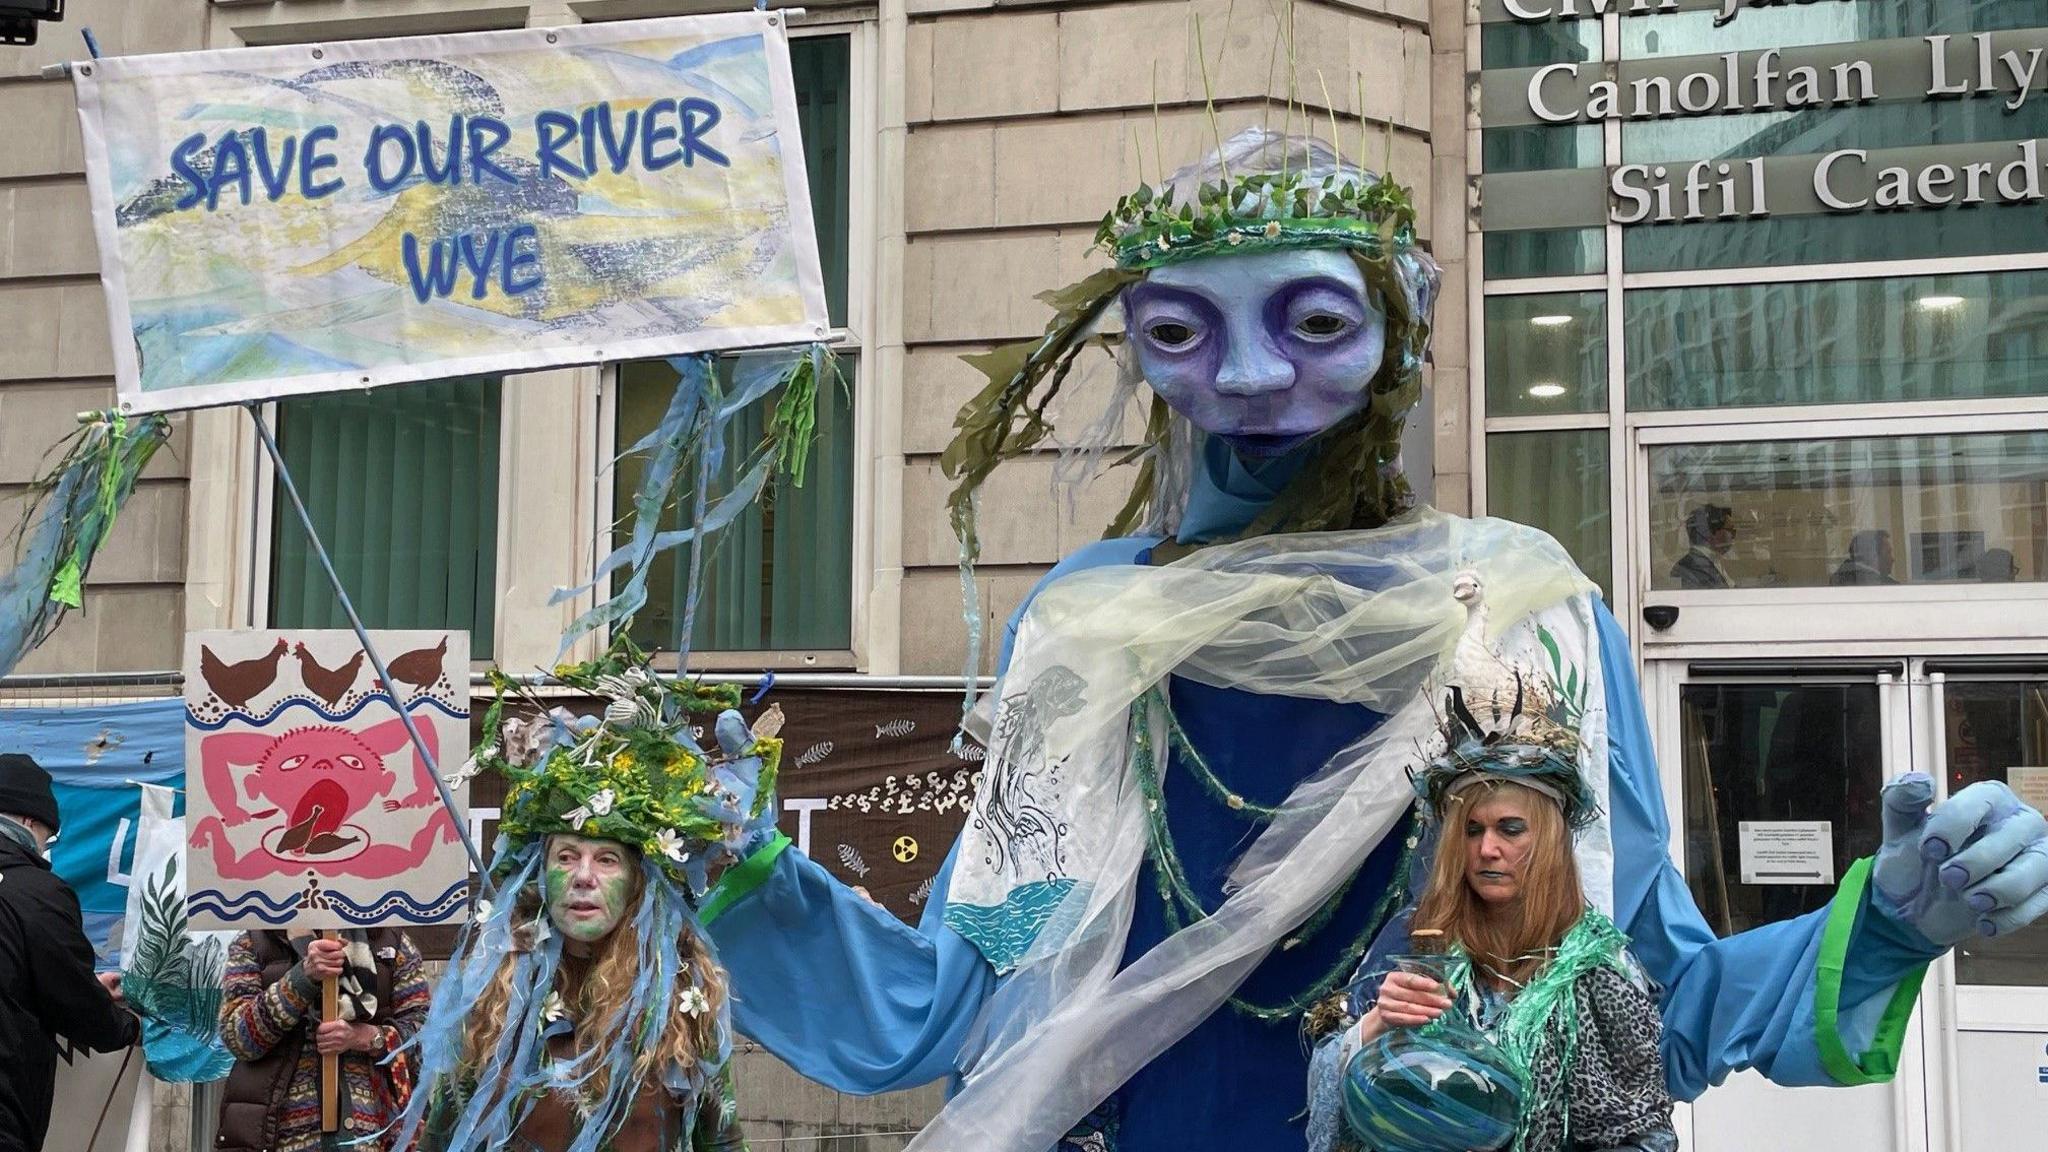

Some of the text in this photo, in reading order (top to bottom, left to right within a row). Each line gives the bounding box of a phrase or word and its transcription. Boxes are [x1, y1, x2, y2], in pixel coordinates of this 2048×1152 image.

[1527, 32, 2043, 122] Canolfan Lly
[170, 97, 731, 212] SAVE OUR RIVER
[1610, 139, 2048, 224] Sifil Caerd
[402, 224, 543, 306] WYE
